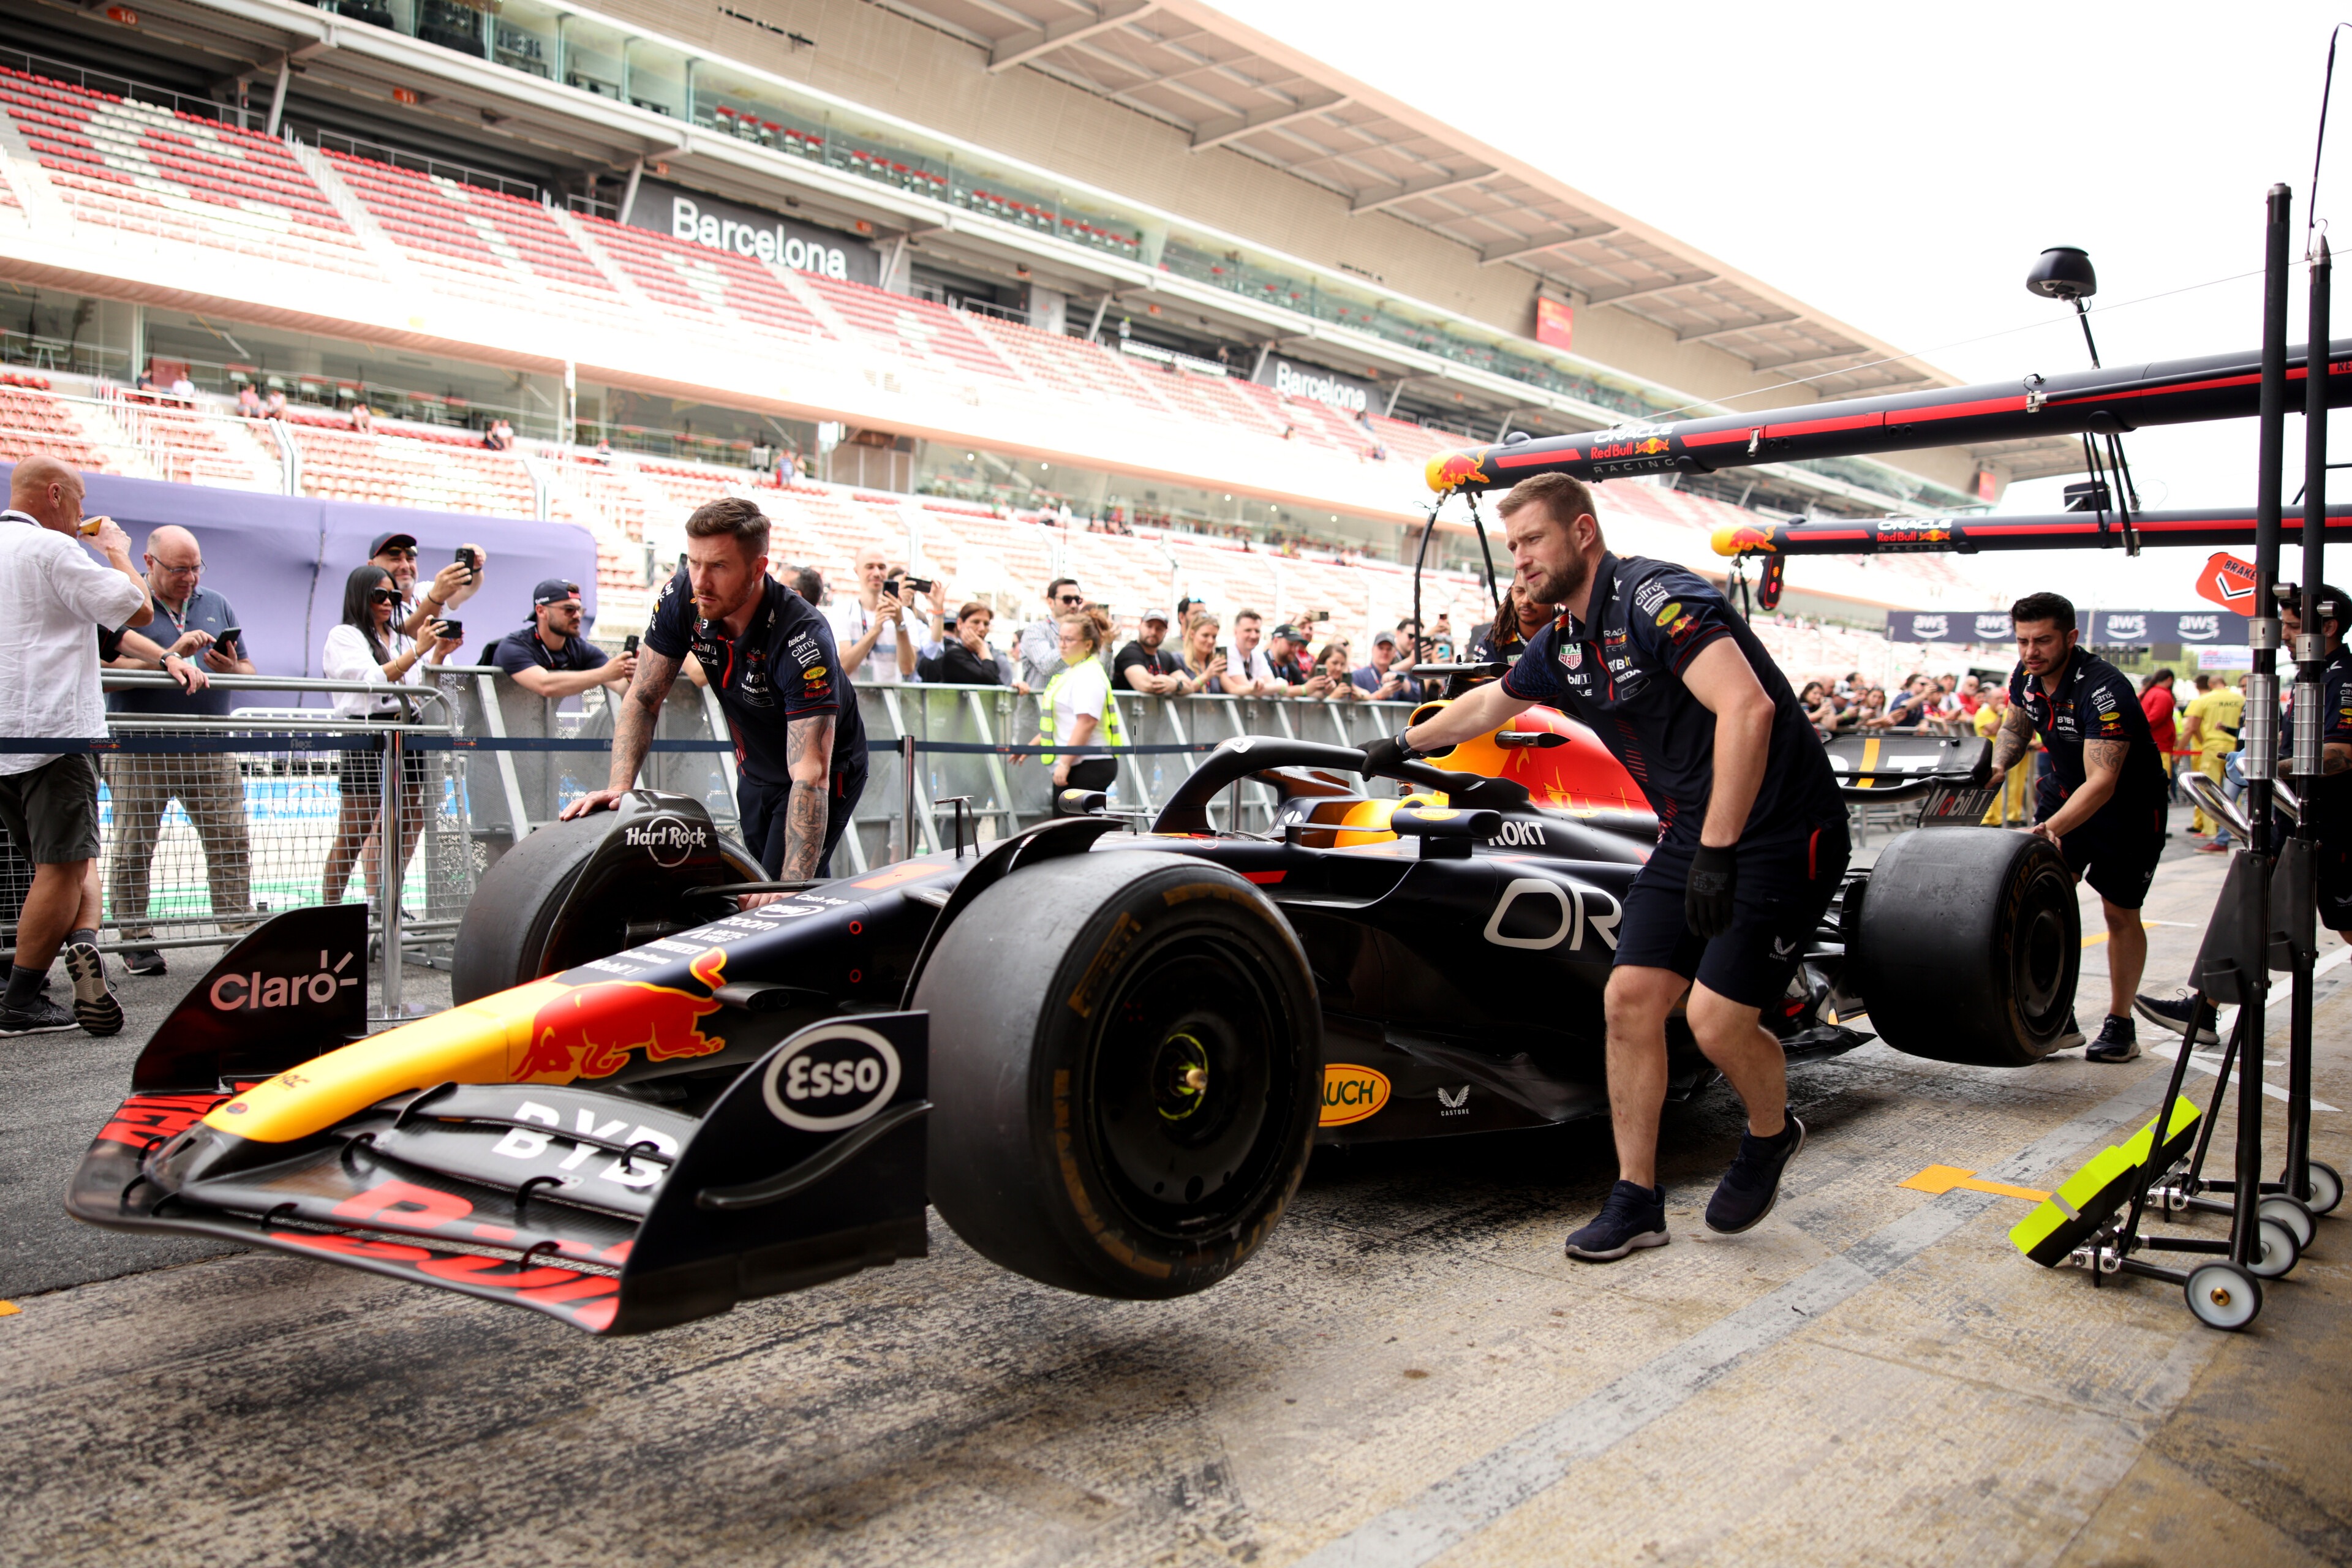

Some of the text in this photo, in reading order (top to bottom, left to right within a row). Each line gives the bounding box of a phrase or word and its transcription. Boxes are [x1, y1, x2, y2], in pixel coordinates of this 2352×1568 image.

[120, 11, 136, 25] 10
[673, 195, 848, 281] Barcelona
[1276, 361, 1366, 411] Barcelona
[1594, 423, 1677, 443] ORACLE
[1591, 442, 1634, 459] Red Bull
[1594, 458, 1675, 474] RACING
[1877, 519, 1953, 530] ORACLE
[1877, 531, 1917, 541] Red Bull
[1635, 582, 1664, 606] citrix
[1913, 614, 1948, 629] aws
[1975, 614, 2011, 629] aws
[2107, 614, 2146, 630] aws
[2179, 614, 2219, 630] aws
[788, 631, 806, 647] telcel
[791, 638, 818, 657] citrix
[1564, 644, 1582, 654] TAG
[1560, 654, 1582, 666] HEUER
[809, 668, 824, 677] RAUCH
[2092, 691, 2114, 705] citrix
[1924, 790, 1978, 816] Mobil
[625, 827, 706, 849] Hard Rock
[718, 917, 780, 930] zoom
[708, 929, 748, 939] ARCTIC
[210, 969, 338, 1011] Claro
[1441, 1108, 1470, 1117] CASTORE
